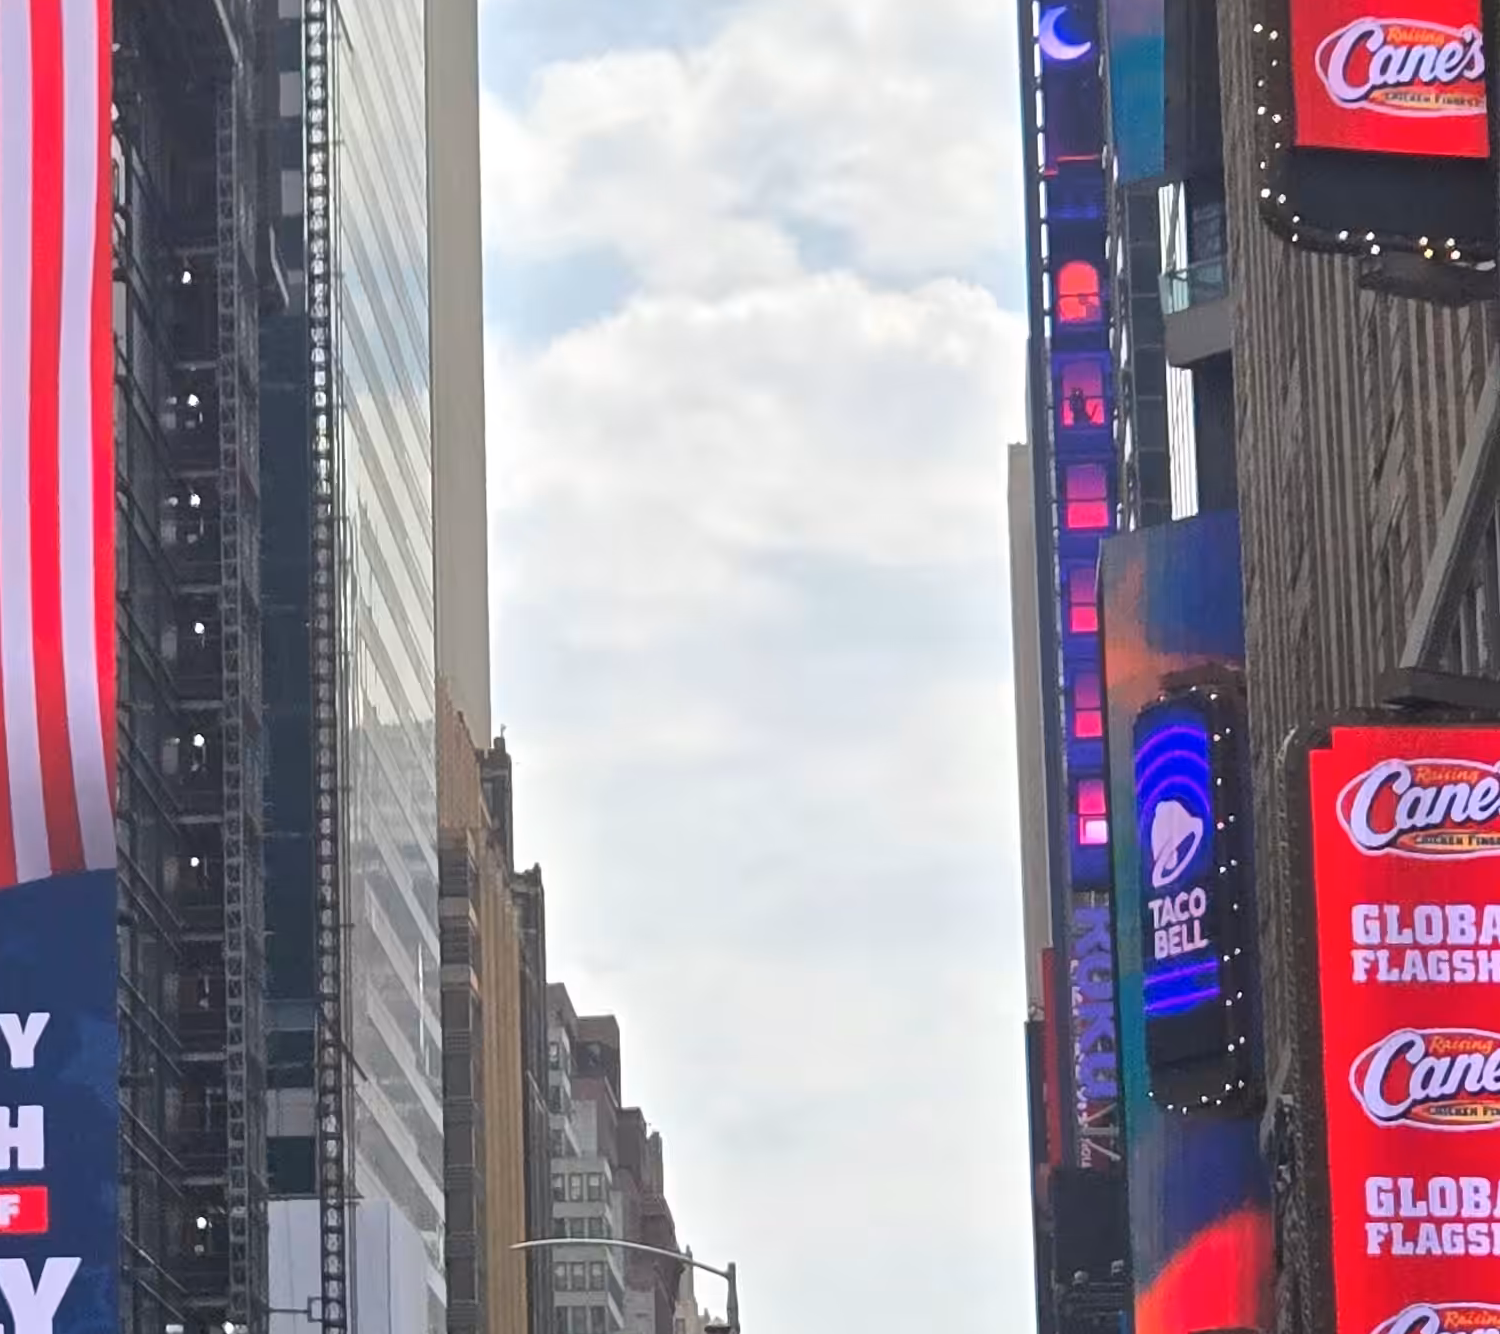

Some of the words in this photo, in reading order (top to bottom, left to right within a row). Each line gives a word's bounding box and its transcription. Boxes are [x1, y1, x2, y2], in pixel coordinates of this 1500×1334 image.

[1328, 20, 1486, 100] Cane's
[1414, 766, 1479, 783] Raising
[1148, 886, 1207, 929] TACO
[1155, 919, 1209, 960] BELL
[1428, 1034, 1494, 1054] Raising
[1365, 1176, 1500, 1218] GLOB
